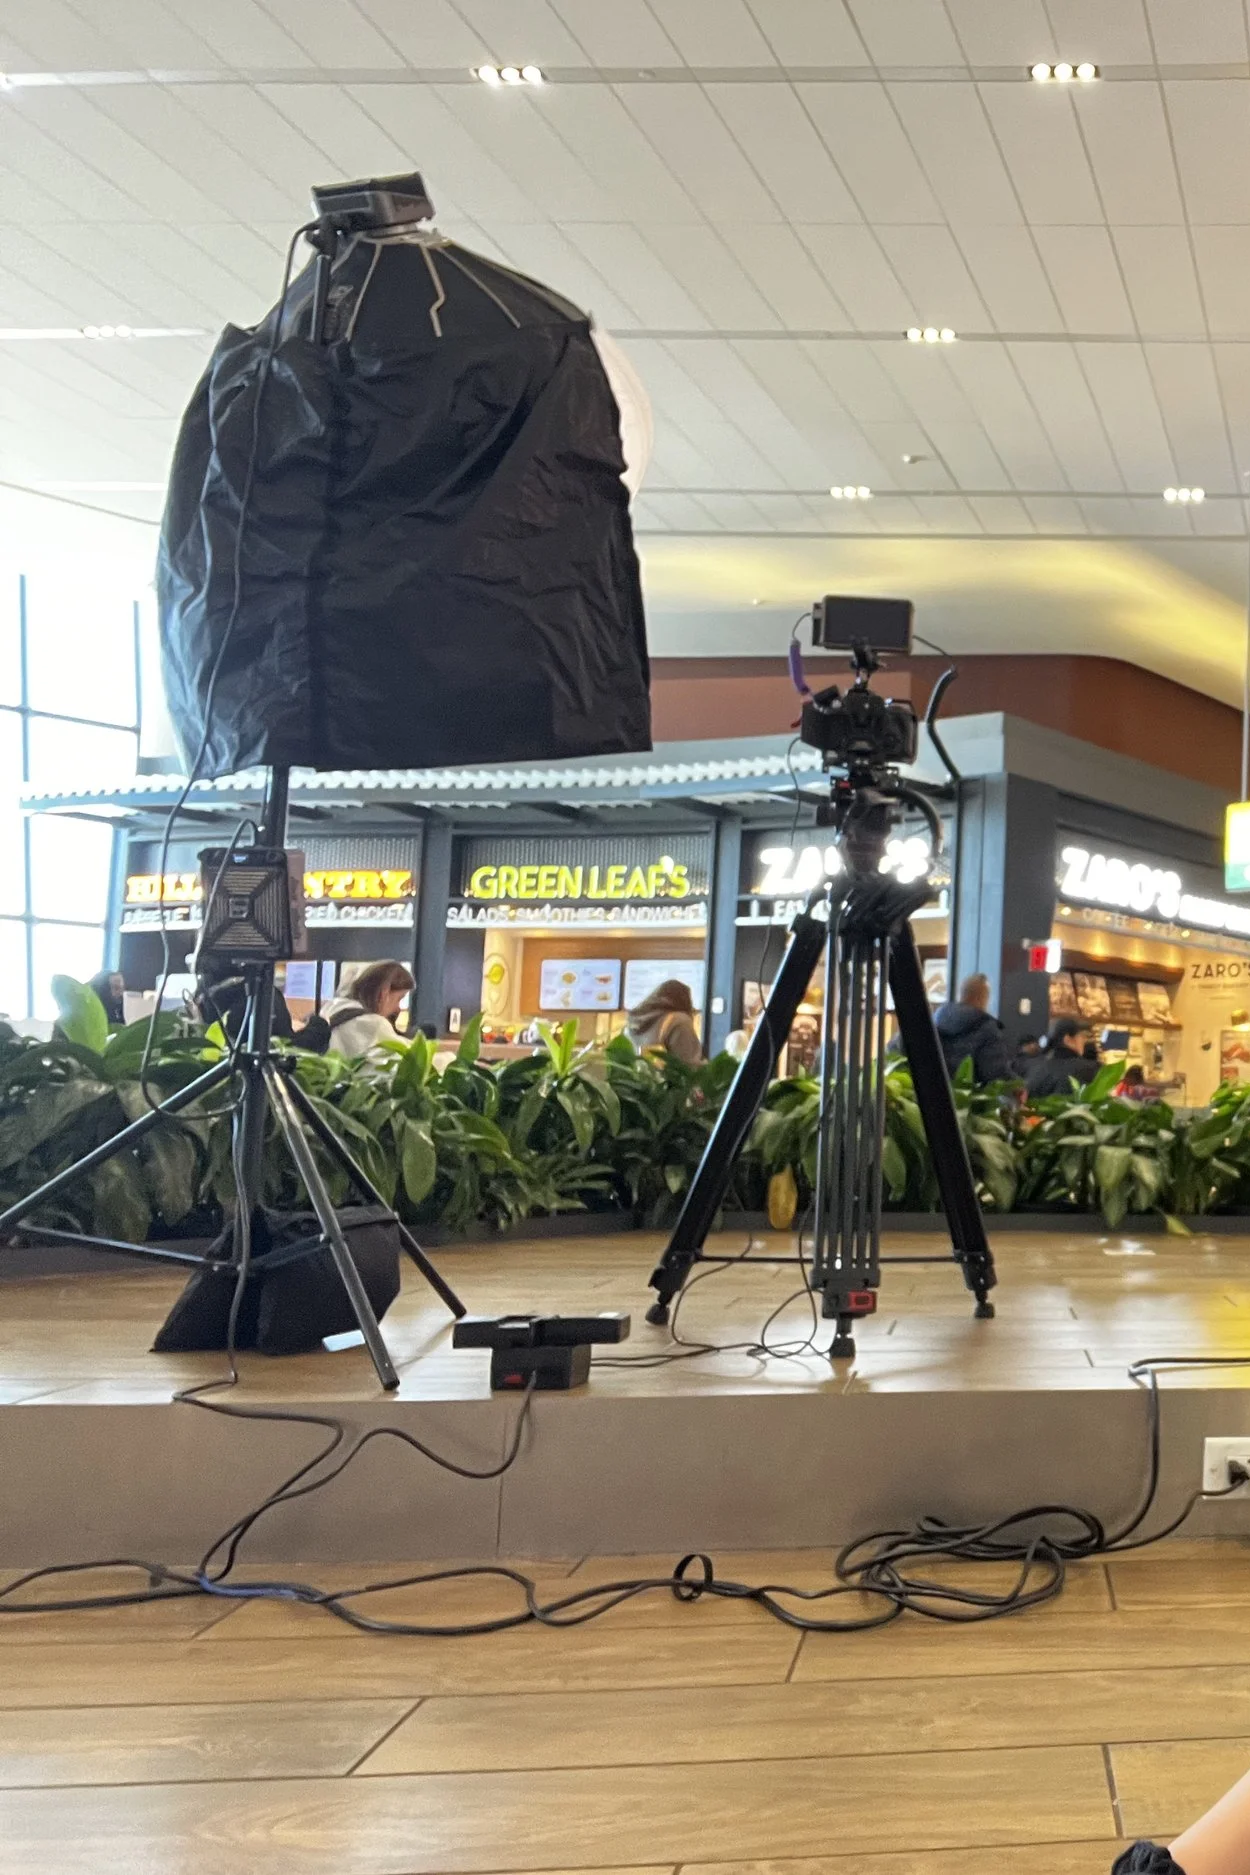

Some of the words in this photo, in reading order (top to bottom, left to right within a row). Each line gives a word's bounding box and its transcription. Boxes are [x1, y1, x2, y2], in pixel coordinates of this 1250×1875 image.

[303, 869, 412, 899] NTRY
[470, 864, 583, 900] GREEN
[586, 856, 690, 900] LEAF'S
[1060, 846, 1182, 918] ZARO'S
[447, 905, 509, 922] SALADS
